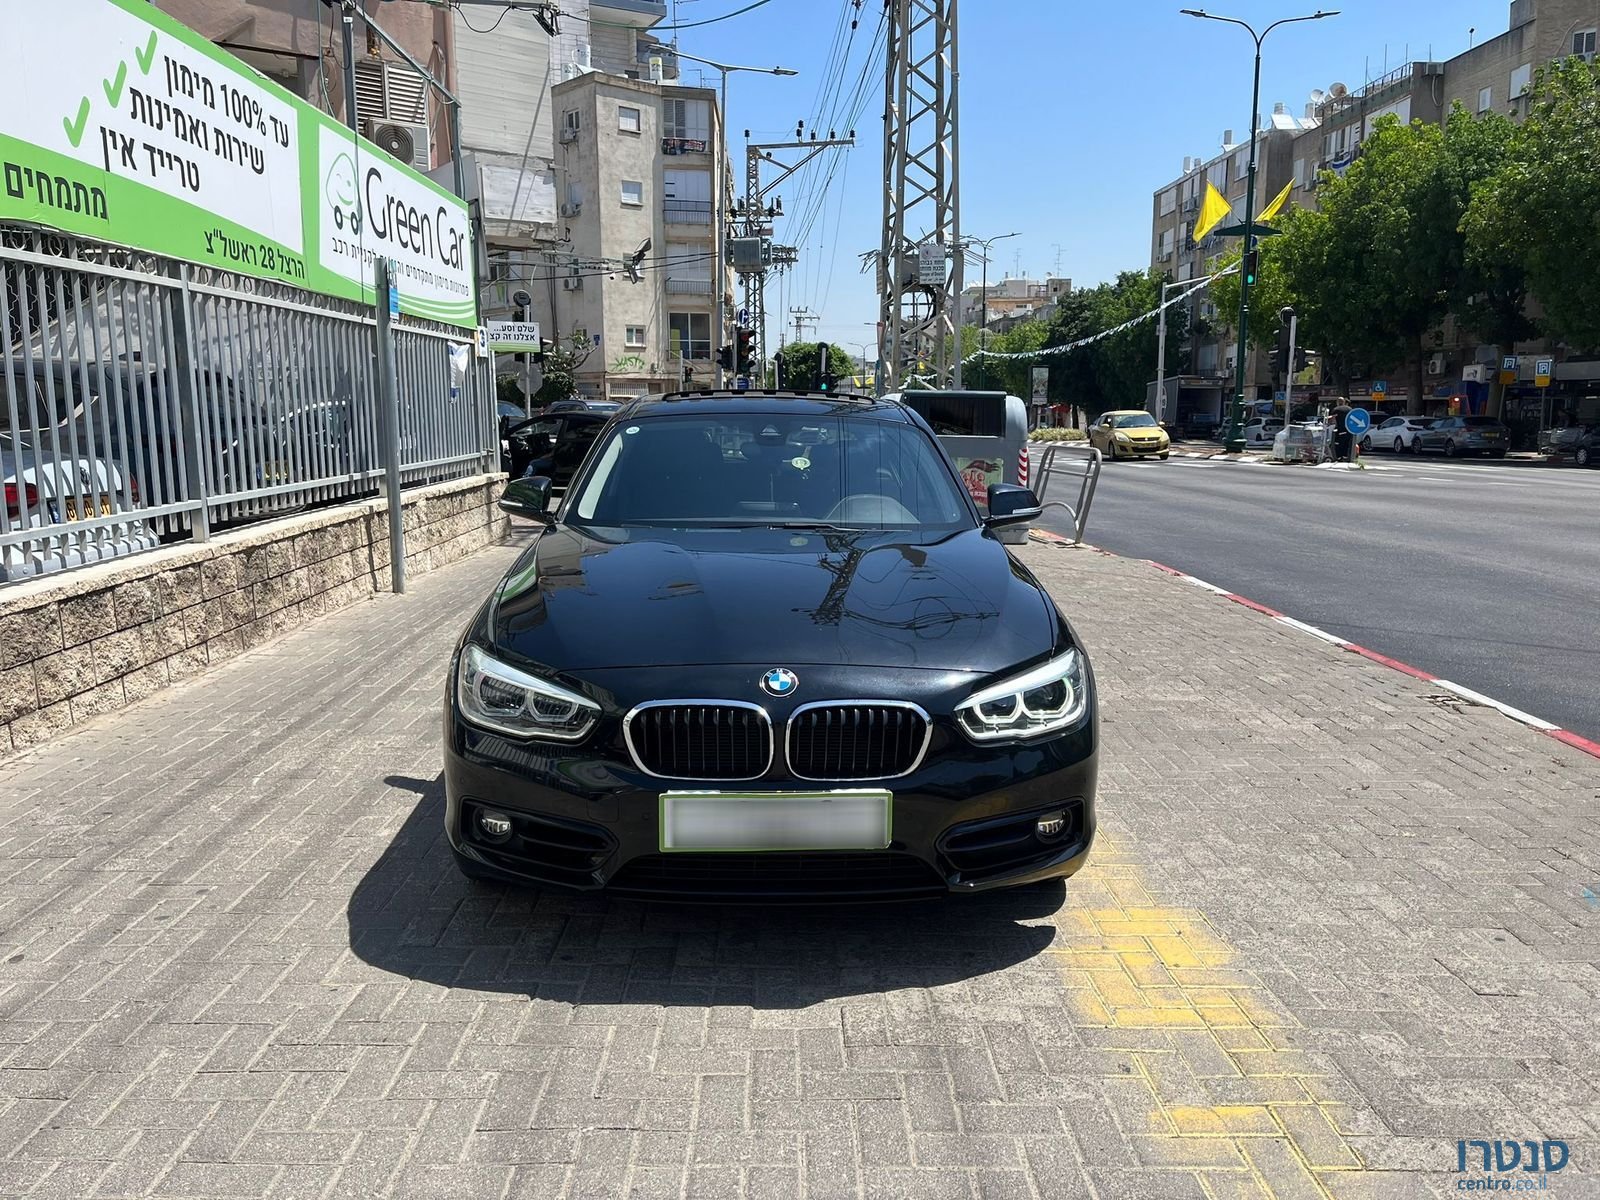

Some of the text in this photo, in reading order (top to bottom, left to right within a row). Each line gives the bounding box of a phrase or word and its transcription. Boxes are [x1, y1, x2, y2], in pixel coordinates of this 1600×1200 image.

[129, 86, 265, 175] שירות ואמינות
[164, 55, 289, 148] עד 100% מימון
[99, 125, 200, 193] טרייד אין
[3, 161, 109, 220] מתמחים
[366, 167, 465, 271] Green Car
[203, 227, 305, 279] הרצל 28 ראשל"צ
[331, 237, 349, 257] רכב
[513, 333, 535, 341] אצלנו
[517, 324, 535, 332] שלם
